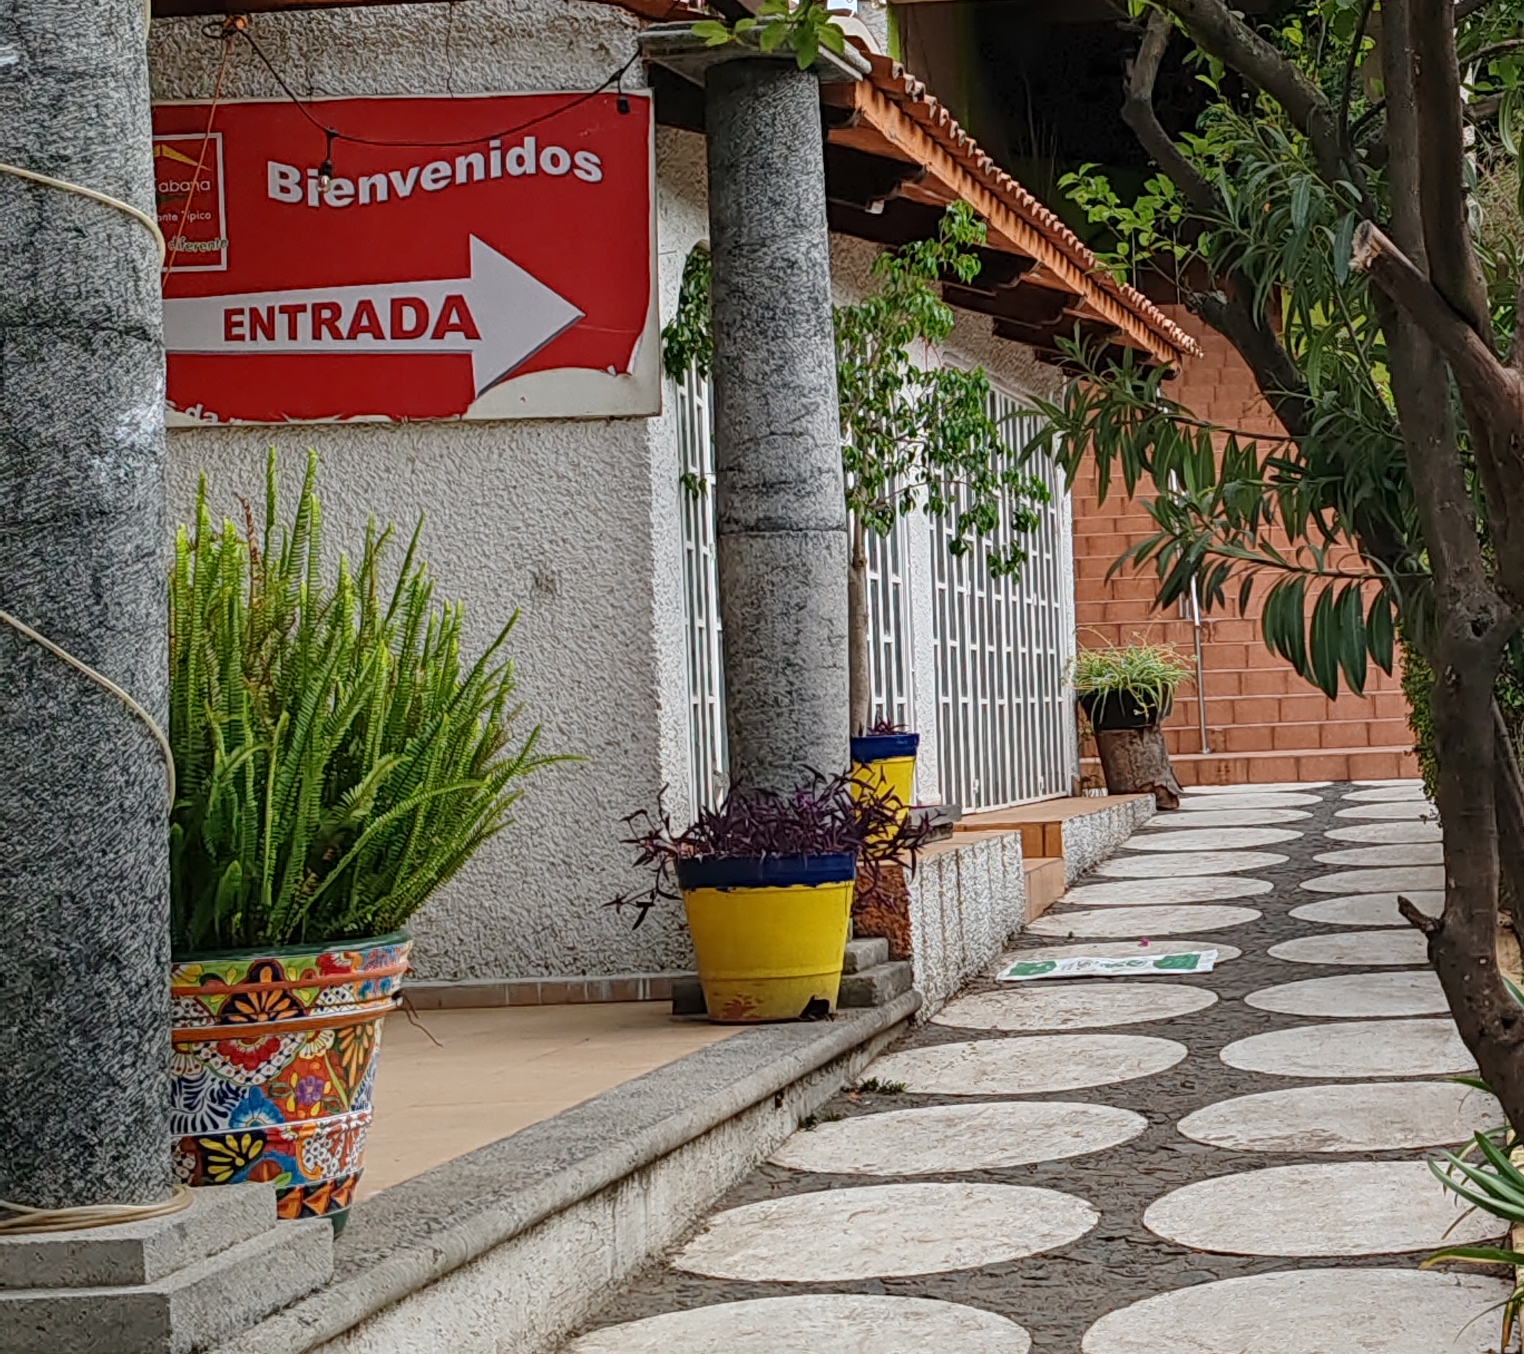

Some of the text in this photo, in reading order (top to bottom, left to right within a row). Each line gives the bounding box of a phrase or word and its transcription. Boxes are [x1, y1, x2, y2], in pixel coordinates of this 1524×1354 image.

[156, 180, 210, 192] abana
[268, 136, 603, 207] Bienvenidos
[223, 295, 481, 341] ENTRADA
